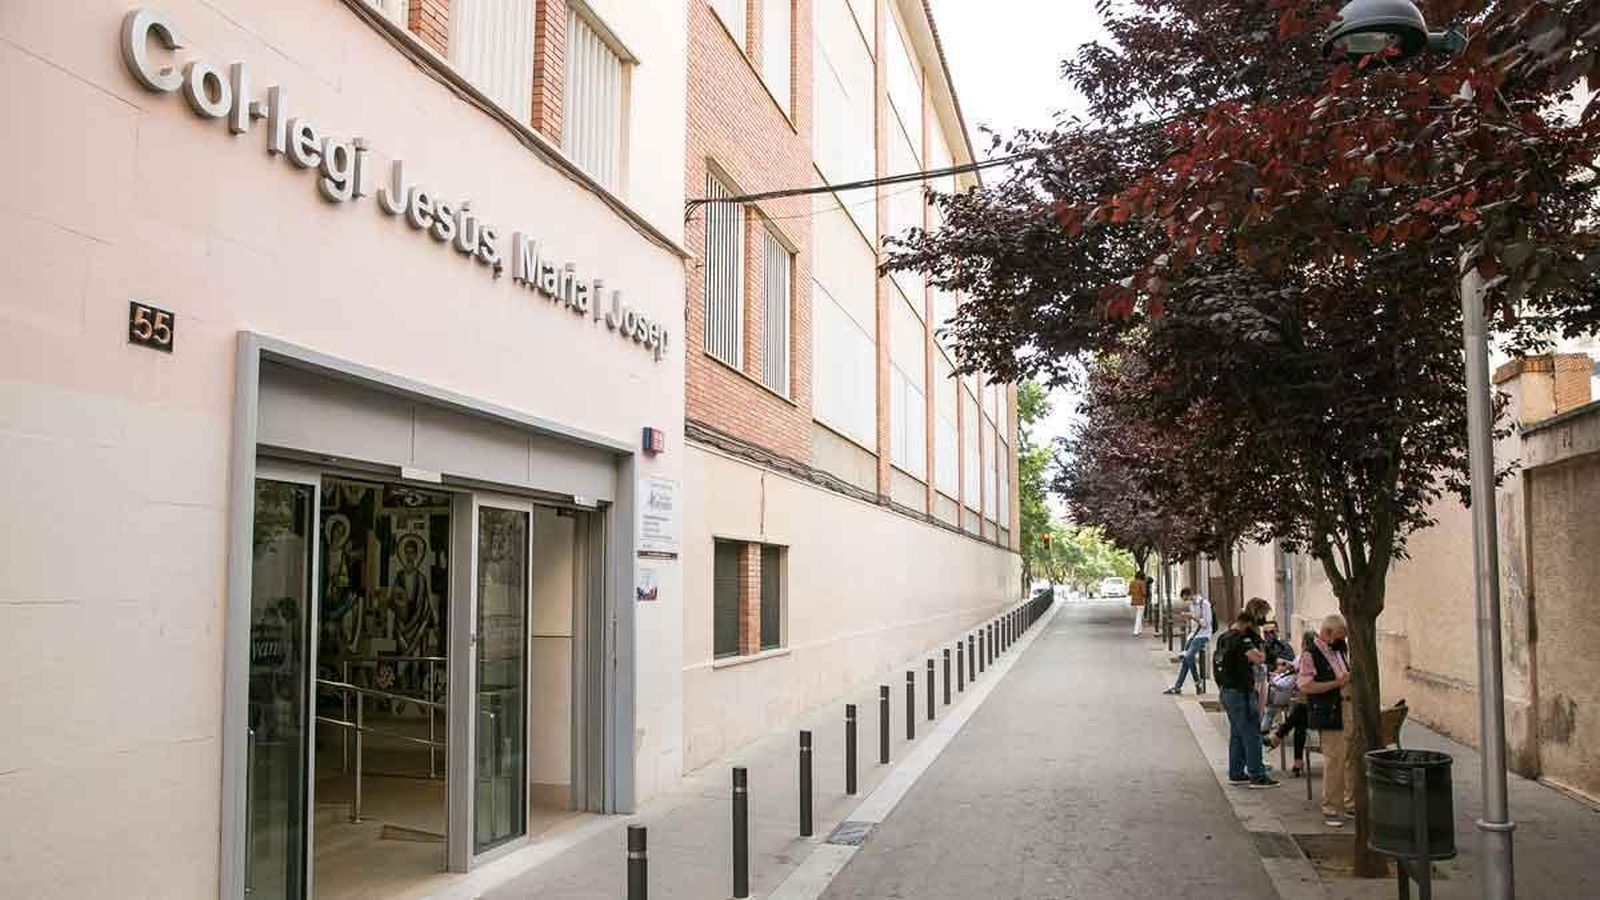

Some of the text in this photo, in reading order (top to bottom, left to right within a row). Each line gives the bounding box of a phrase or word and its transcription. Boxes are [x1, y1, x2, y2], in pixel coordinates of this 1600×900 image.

[121, 8, 377, 202] Col·legi
[376, 158, 503, 280] Jesús,
[593, 279, 606, 323] i
[605, 290, 670, 362] Josep
[133, 306, 171, 345] 55
